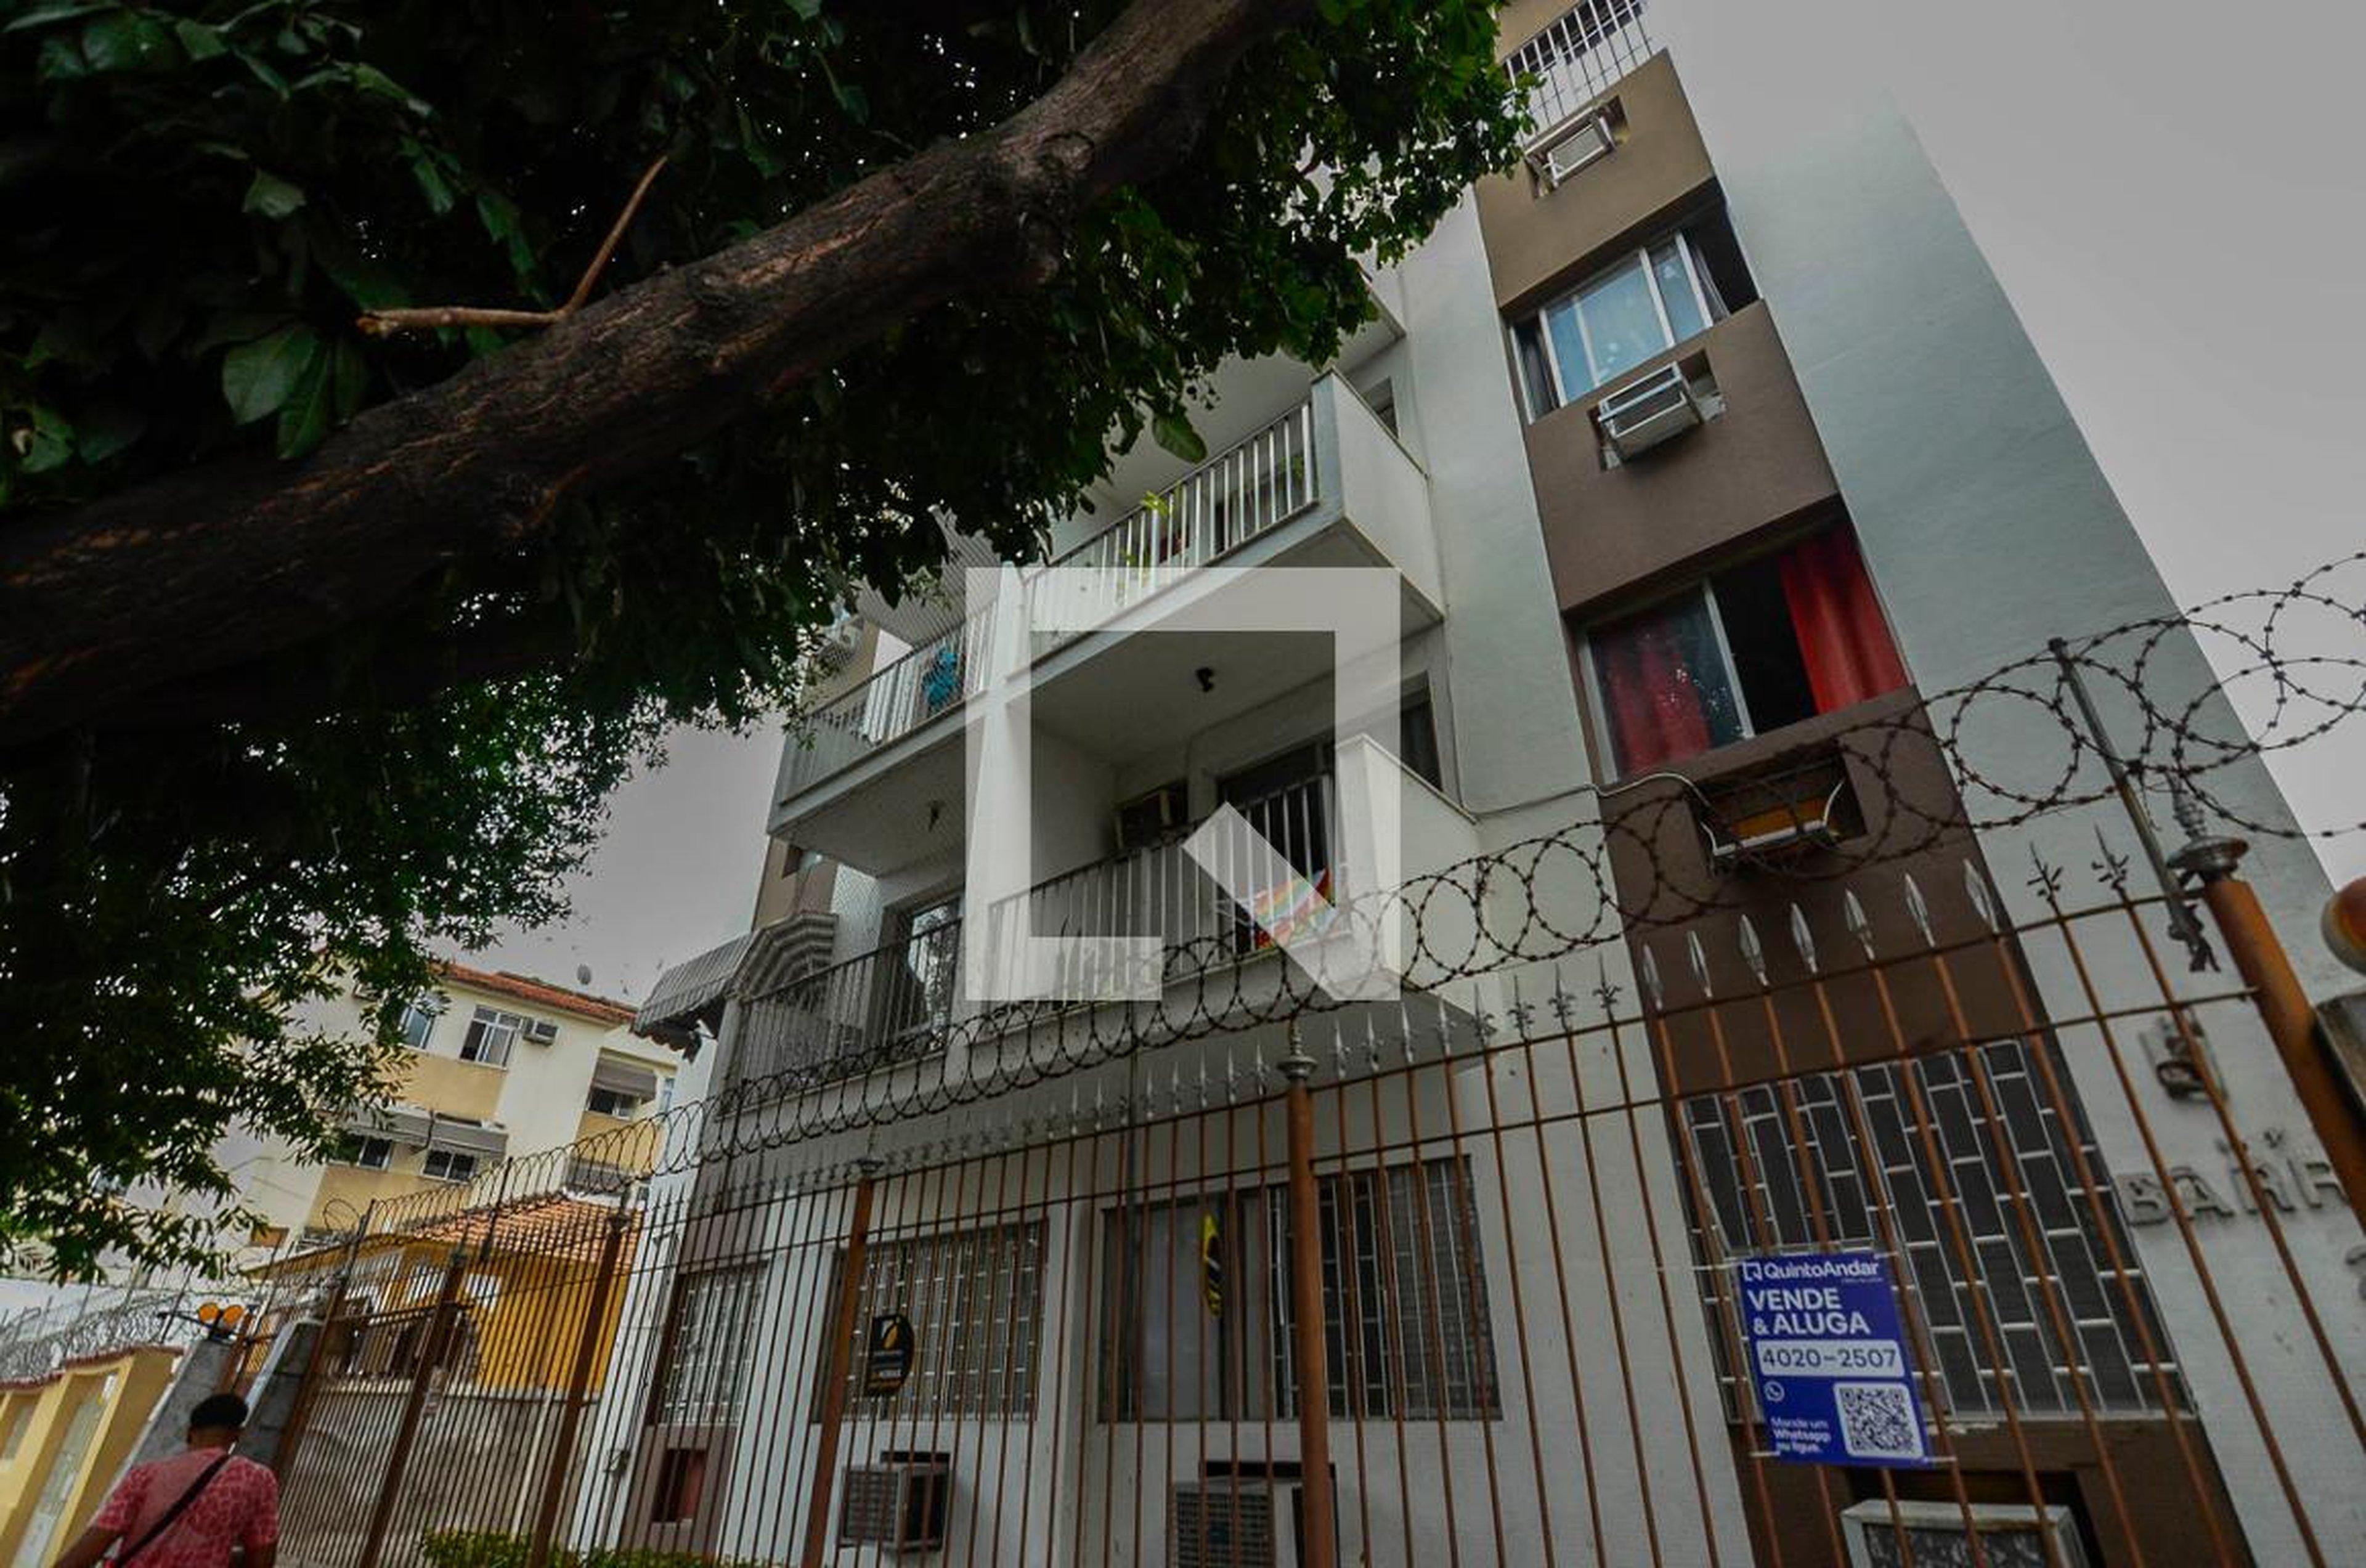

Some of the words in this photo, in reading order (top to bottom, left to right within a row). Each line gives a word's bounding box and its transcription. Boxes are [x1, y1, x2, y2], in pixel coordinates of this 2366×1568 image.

[1764, 1260, 1879, 1280] QuintoAndar
[1747, 1287, 1842, 1311] VENDE
[1753, 1317, 1770, 1335] &
[1773, 1311, 1871, 1335] ALUGA
[1762, 1347, 1897, 1368] 4020-2507
